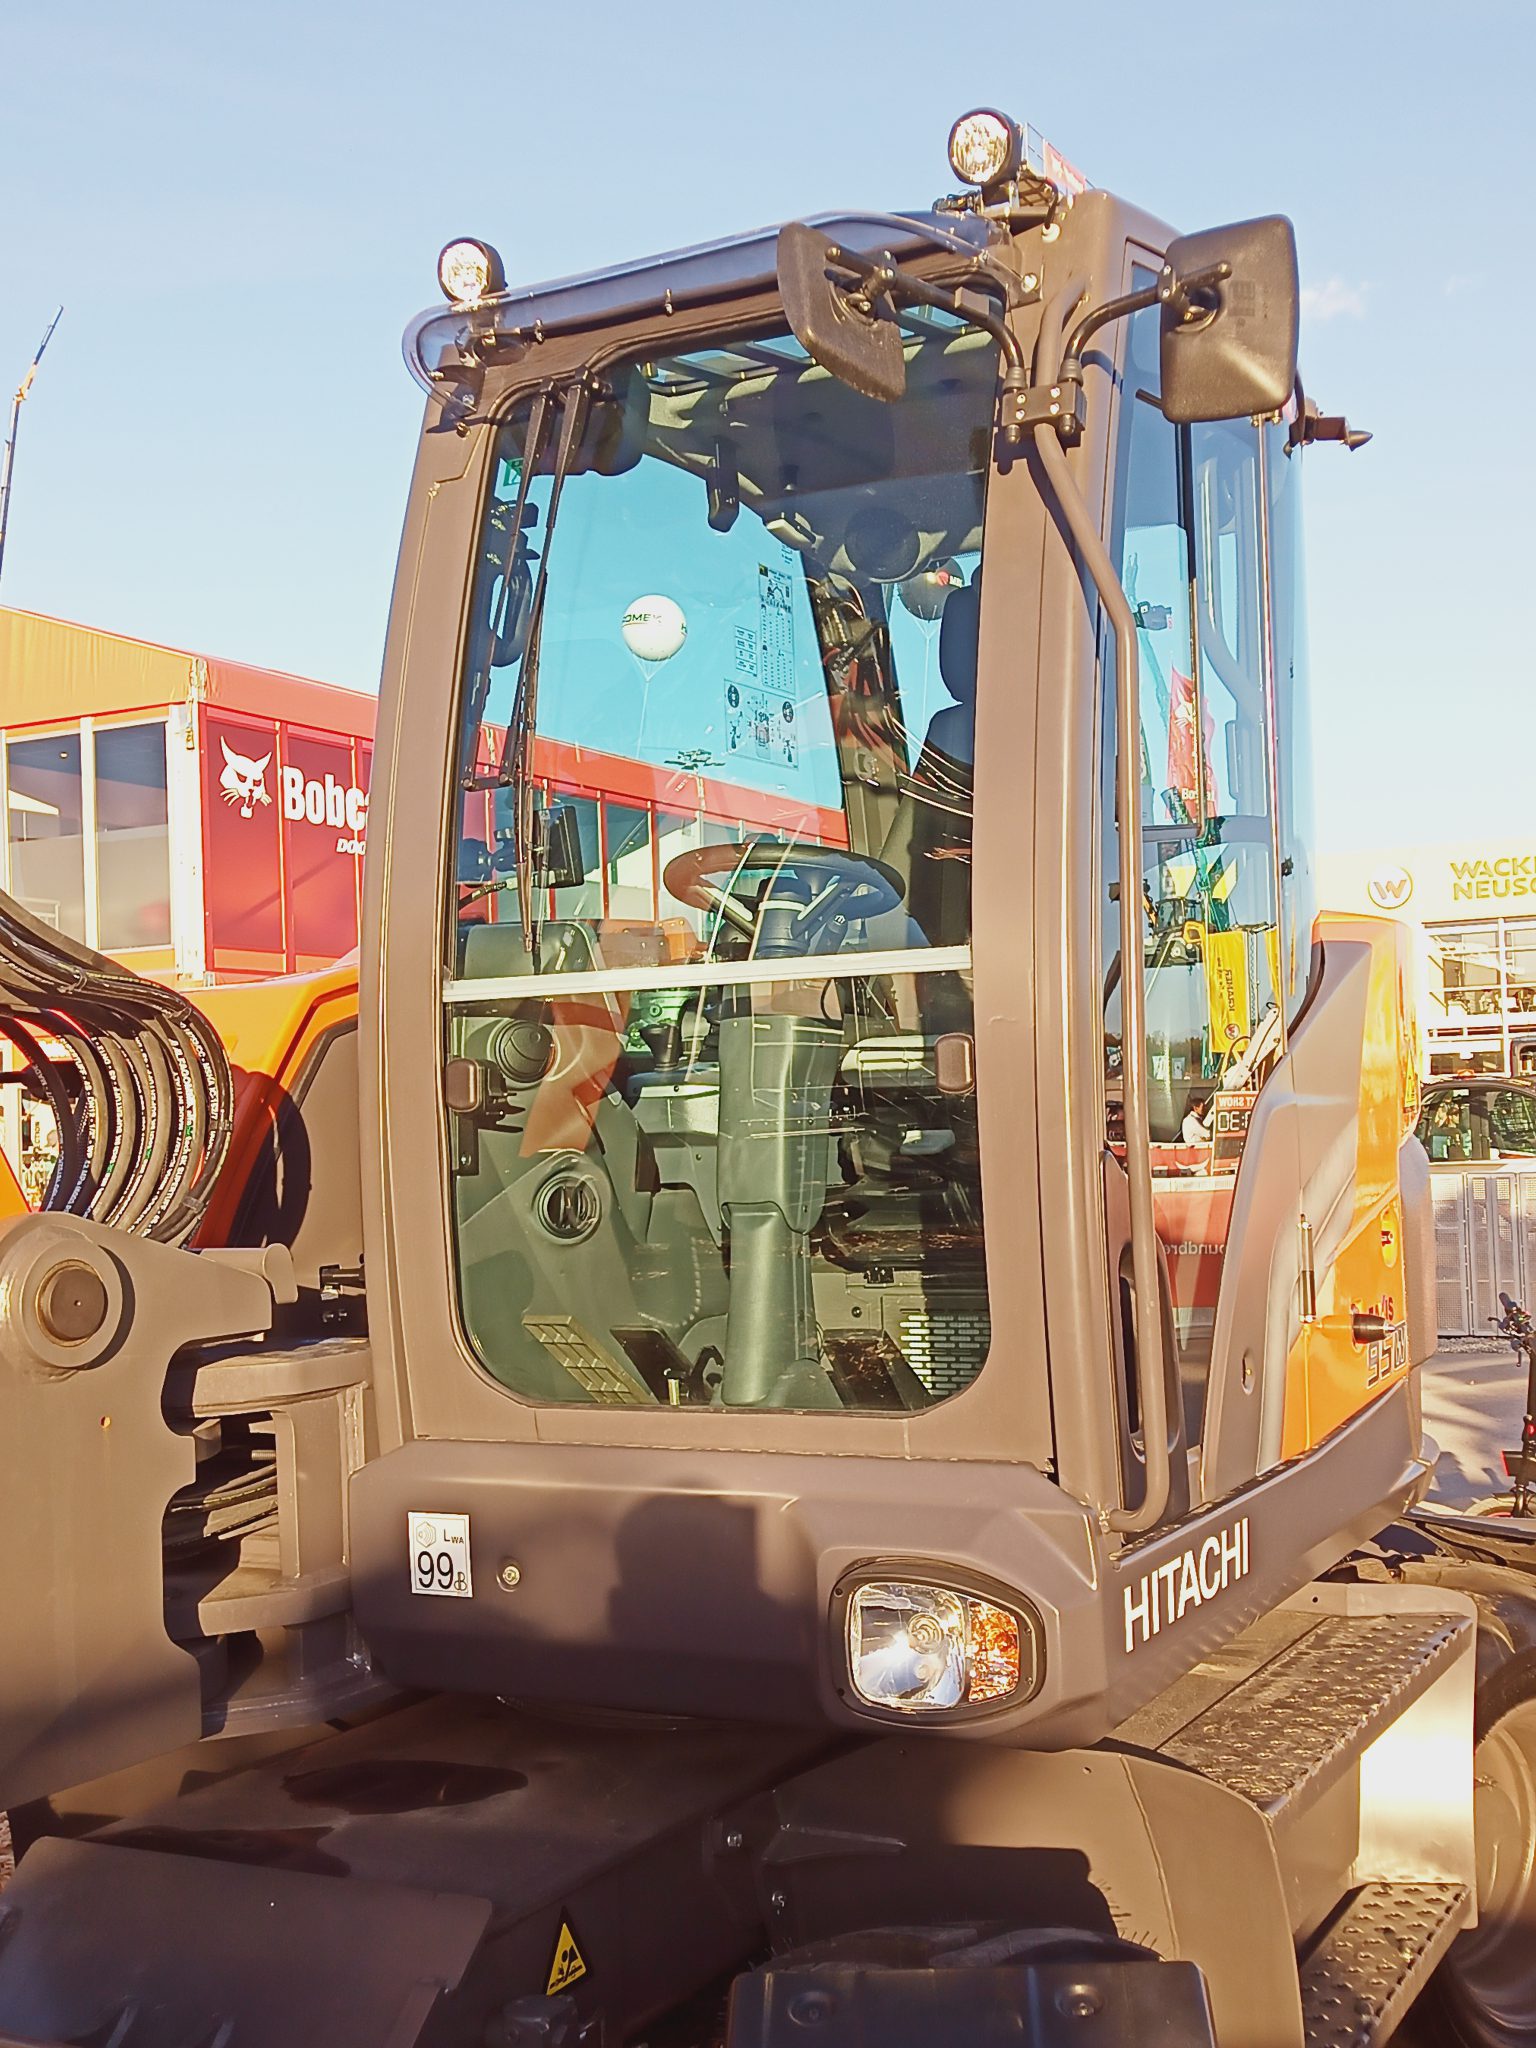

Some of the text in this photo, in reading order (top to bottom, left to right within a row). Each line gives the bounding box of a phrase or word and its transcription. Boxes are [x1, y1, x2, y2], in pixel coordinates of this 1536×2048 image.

[282, 766, 370, 831] Bobc
[1450, 856, 1536, 880] WACK
[417, 1550, 454, 1590] 99
[1123, 1517, 1250, 1654] HITACHI
